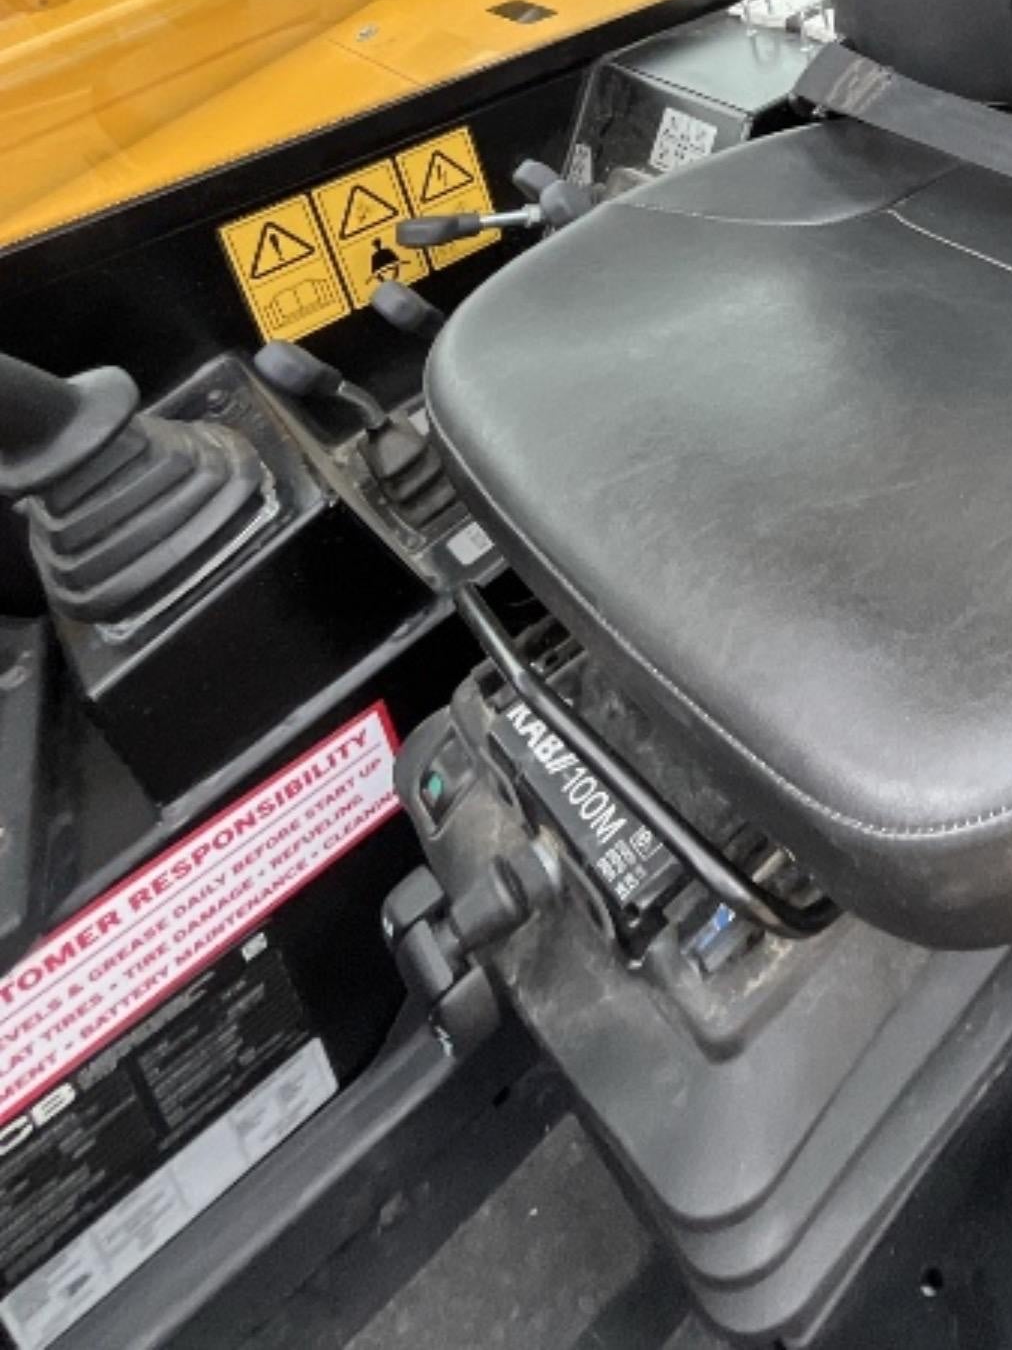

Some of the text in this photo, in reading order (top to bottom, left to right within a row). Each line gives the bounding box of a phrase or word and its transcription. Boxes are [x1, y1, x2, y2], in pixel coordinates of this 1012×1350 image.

[40, 992, 105, 1040] TIRES
[122, 941, 169, 979] TIRE
[172, 877, 254, 943] DAMAGE
[268, 793, 364, 870] REFUELING
[88, 917, 169, 982] GREASE
[172, 873, 228, 919] DAILY
[232, 818, 299, 875] BEFORE
[304, 776, 356, 820] START
[359, 757, 382, 779] UP
[127, 727, 368, 914] RESPONSIBILITY
[79, 964, 169, 1040] BATTERY
[174, 859, 309, 967] MAINTENANCE
